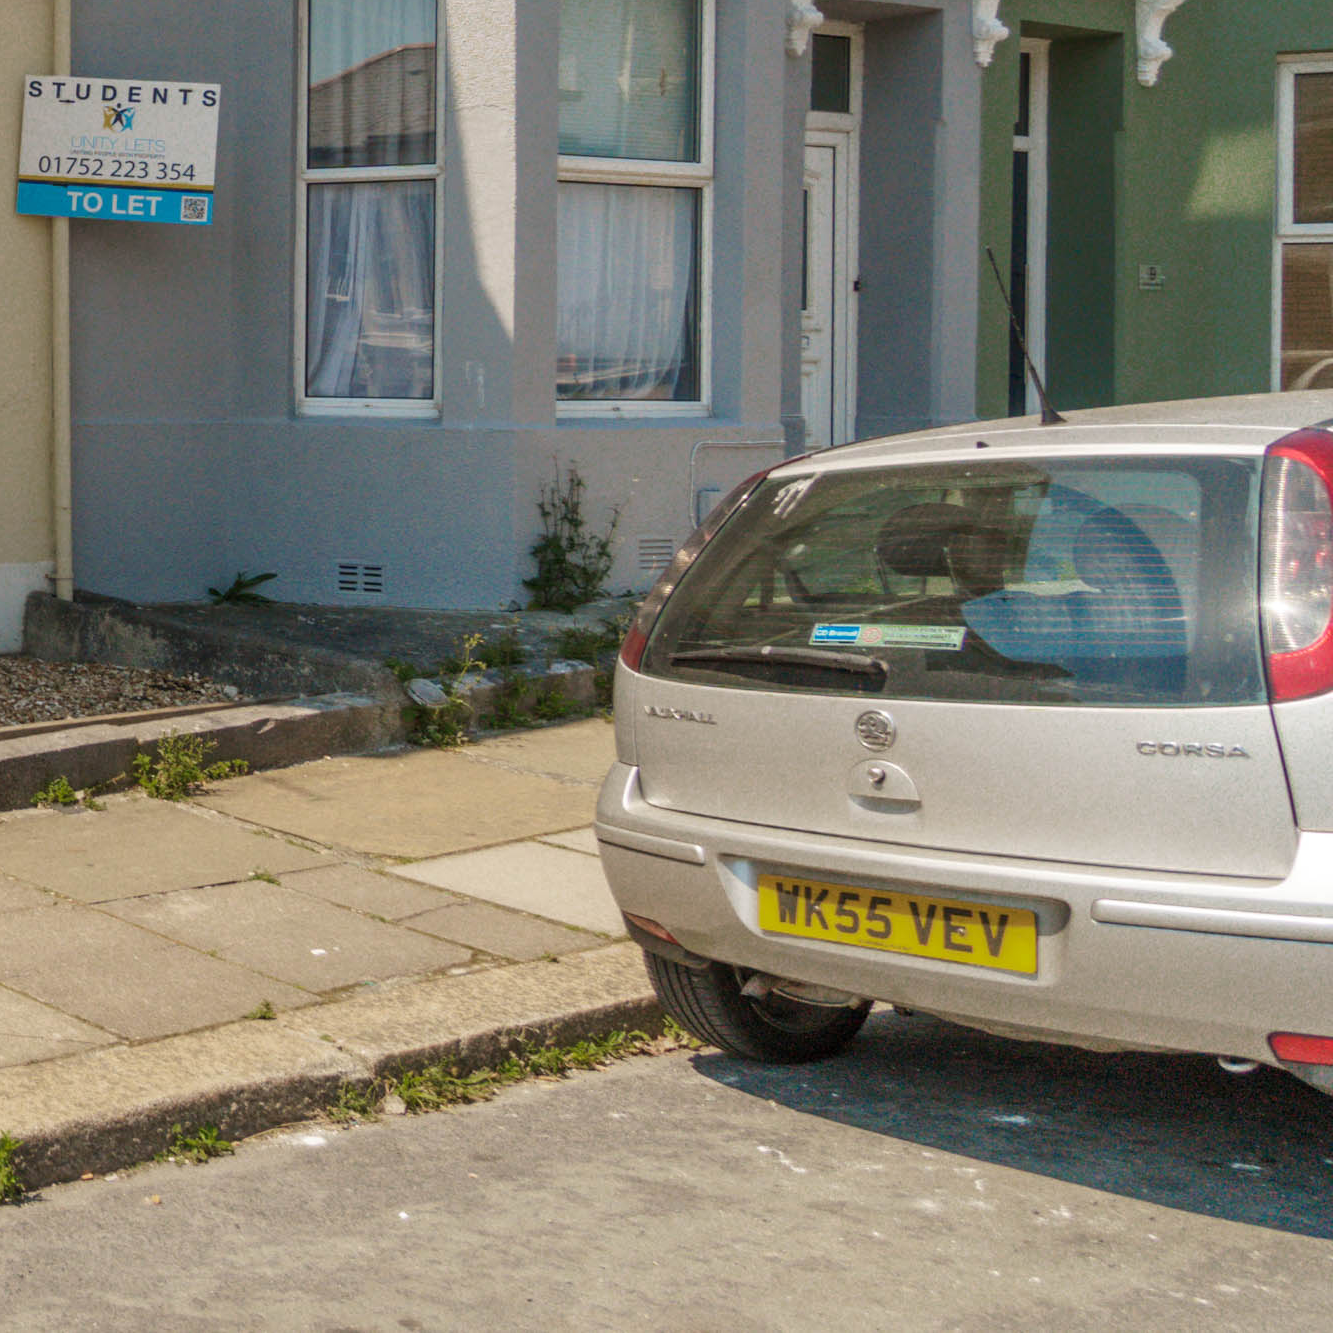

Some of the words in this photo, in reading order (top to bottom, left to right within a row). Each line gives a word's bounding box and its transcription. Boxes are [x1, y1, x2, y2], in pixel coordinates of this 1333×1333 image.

[28, 80, 217, 107] STUDENTS
[71, 136, 118, 150] UNITY
[124, 138, 166, 153] LETS
[38, 155, 103, 177] 01752
[110, 159, 149, 179] 223
[156, 161, 196, 181] 354
[67, 190, 104, 213] TO
[111, 193, 163, 216] LET
[644, 705, 718, 726] VAUXHALL
[1136, 740, 1252, 760] CORSA
[775, 881, 893, 940] WK55
[907, 900, 1010, 958] VEV
